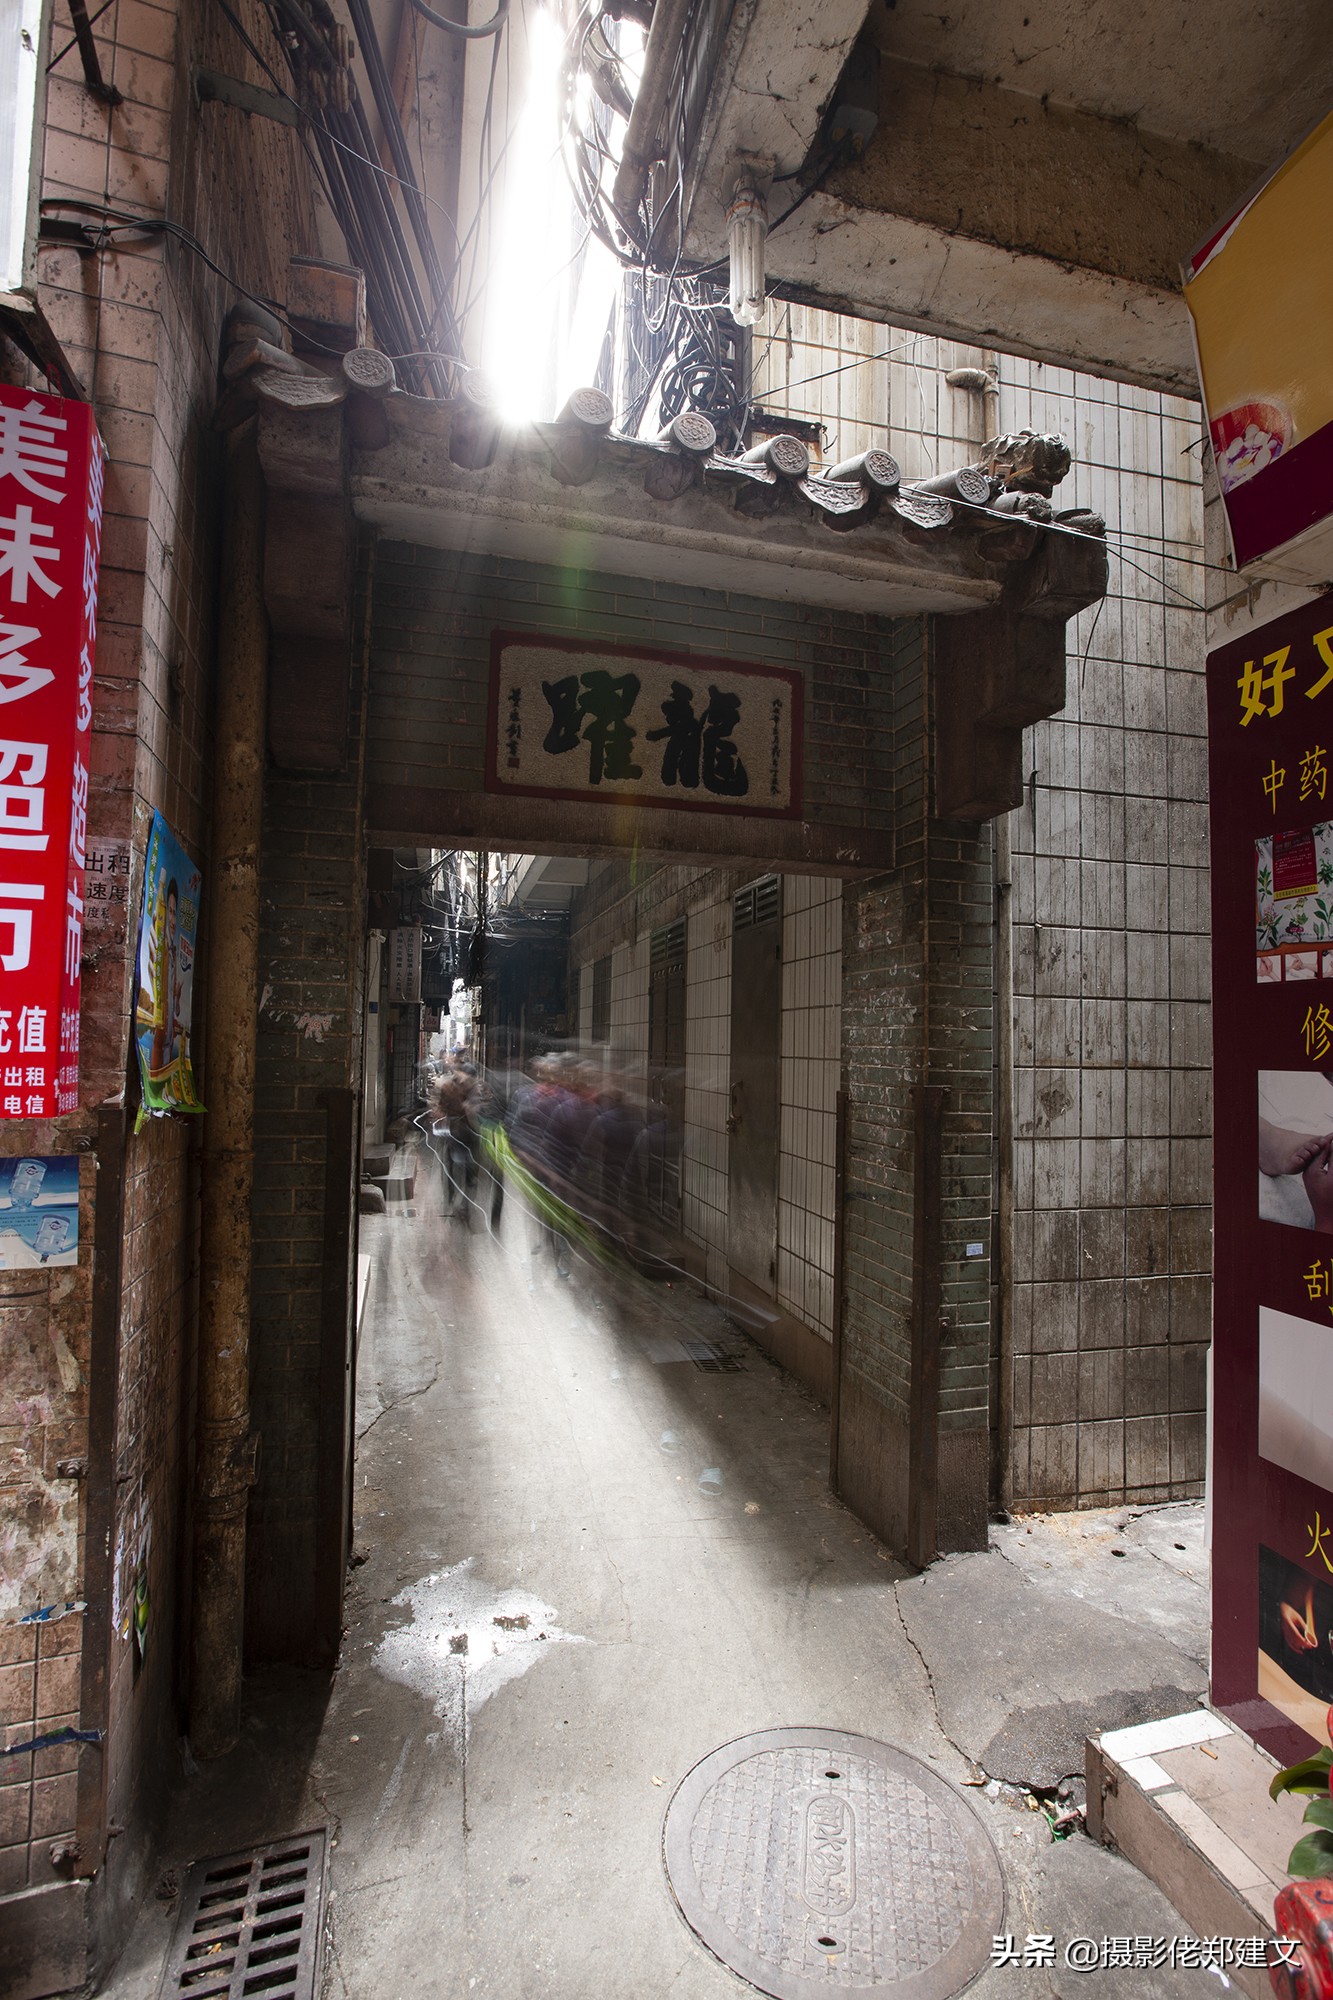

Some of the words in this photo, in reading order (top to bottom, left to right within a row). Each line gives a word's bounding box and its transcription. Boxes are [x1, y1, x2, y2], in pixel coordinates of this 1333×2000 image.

[64, 435, 104, 986] 美味多超市
[1262, 745, 1328, 815] 中药
[4, 1094, 45, 1115] 电信
